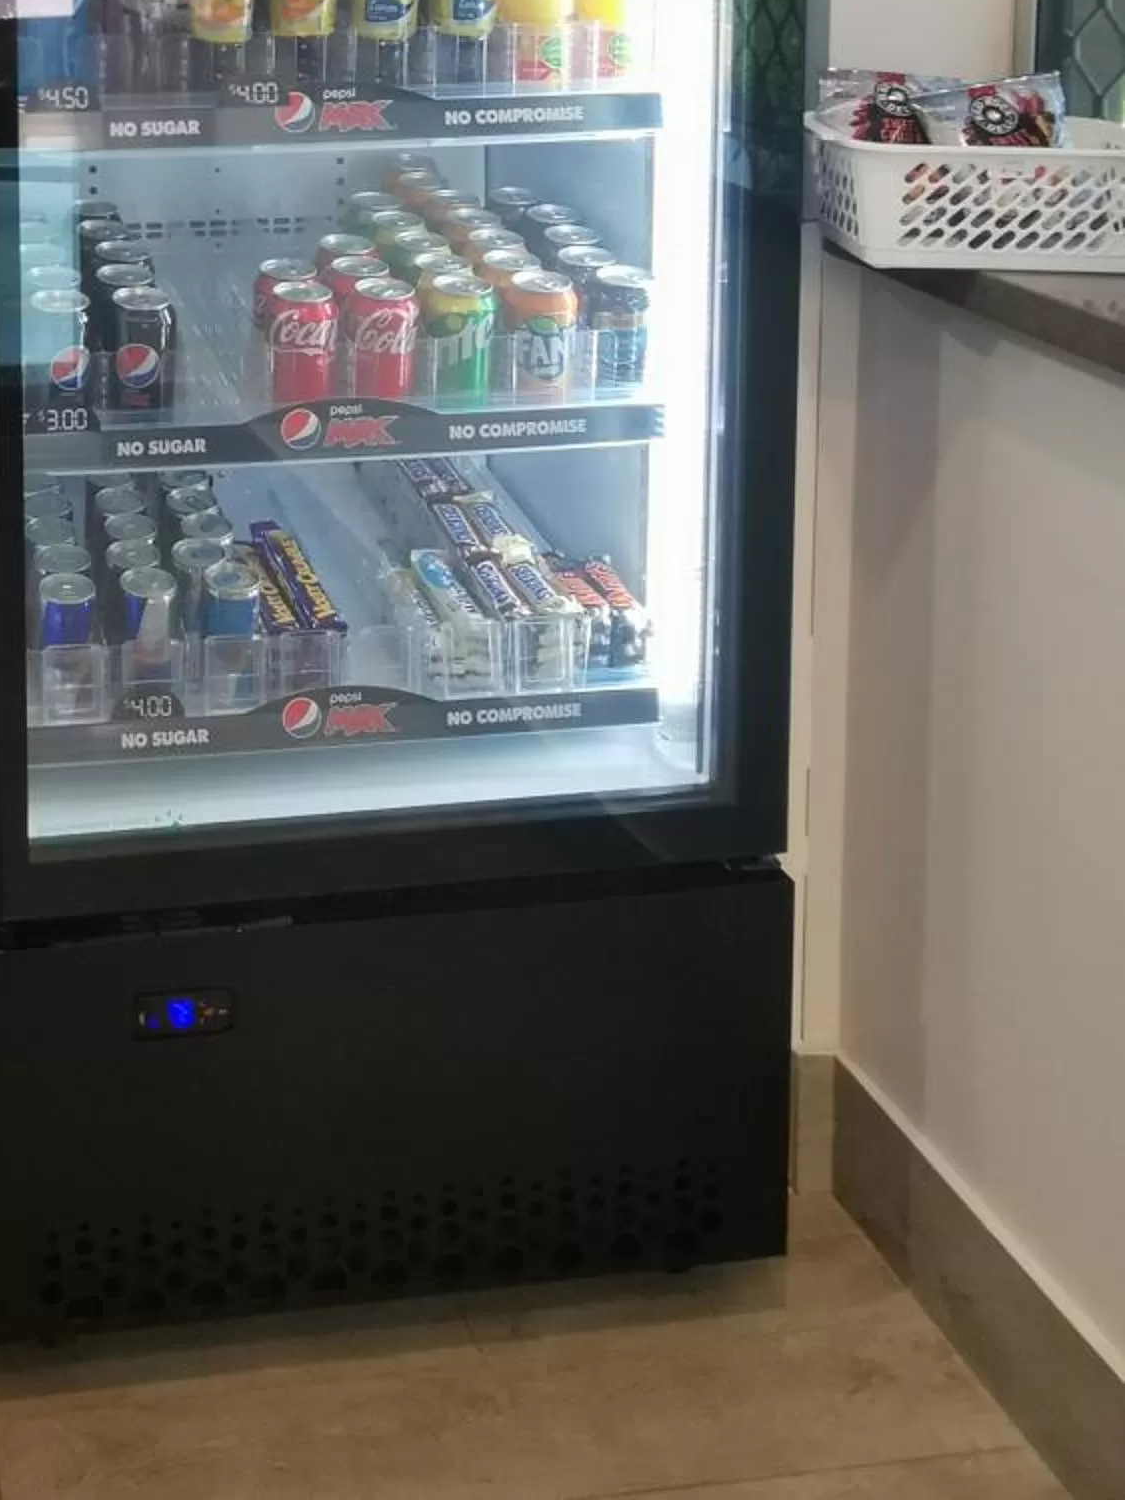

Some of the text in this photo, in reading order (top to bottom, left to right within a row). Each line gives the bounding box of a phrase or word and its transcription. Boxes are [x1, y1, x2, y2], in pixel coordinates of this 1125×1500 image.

[323, 87, 356, 100] pepsi
[444, 105, 585, 125] NO COMPROMISE
[109, 119, 200, 137] NO SUGAR
[448, 418, 586, 440] NO COMPROMISE
[116, 438, 206, 457] NO SUGAR
[446, 703, 582, 726] NO COMPROMISE
[121, 728, 210, 749] NO SUGAR
